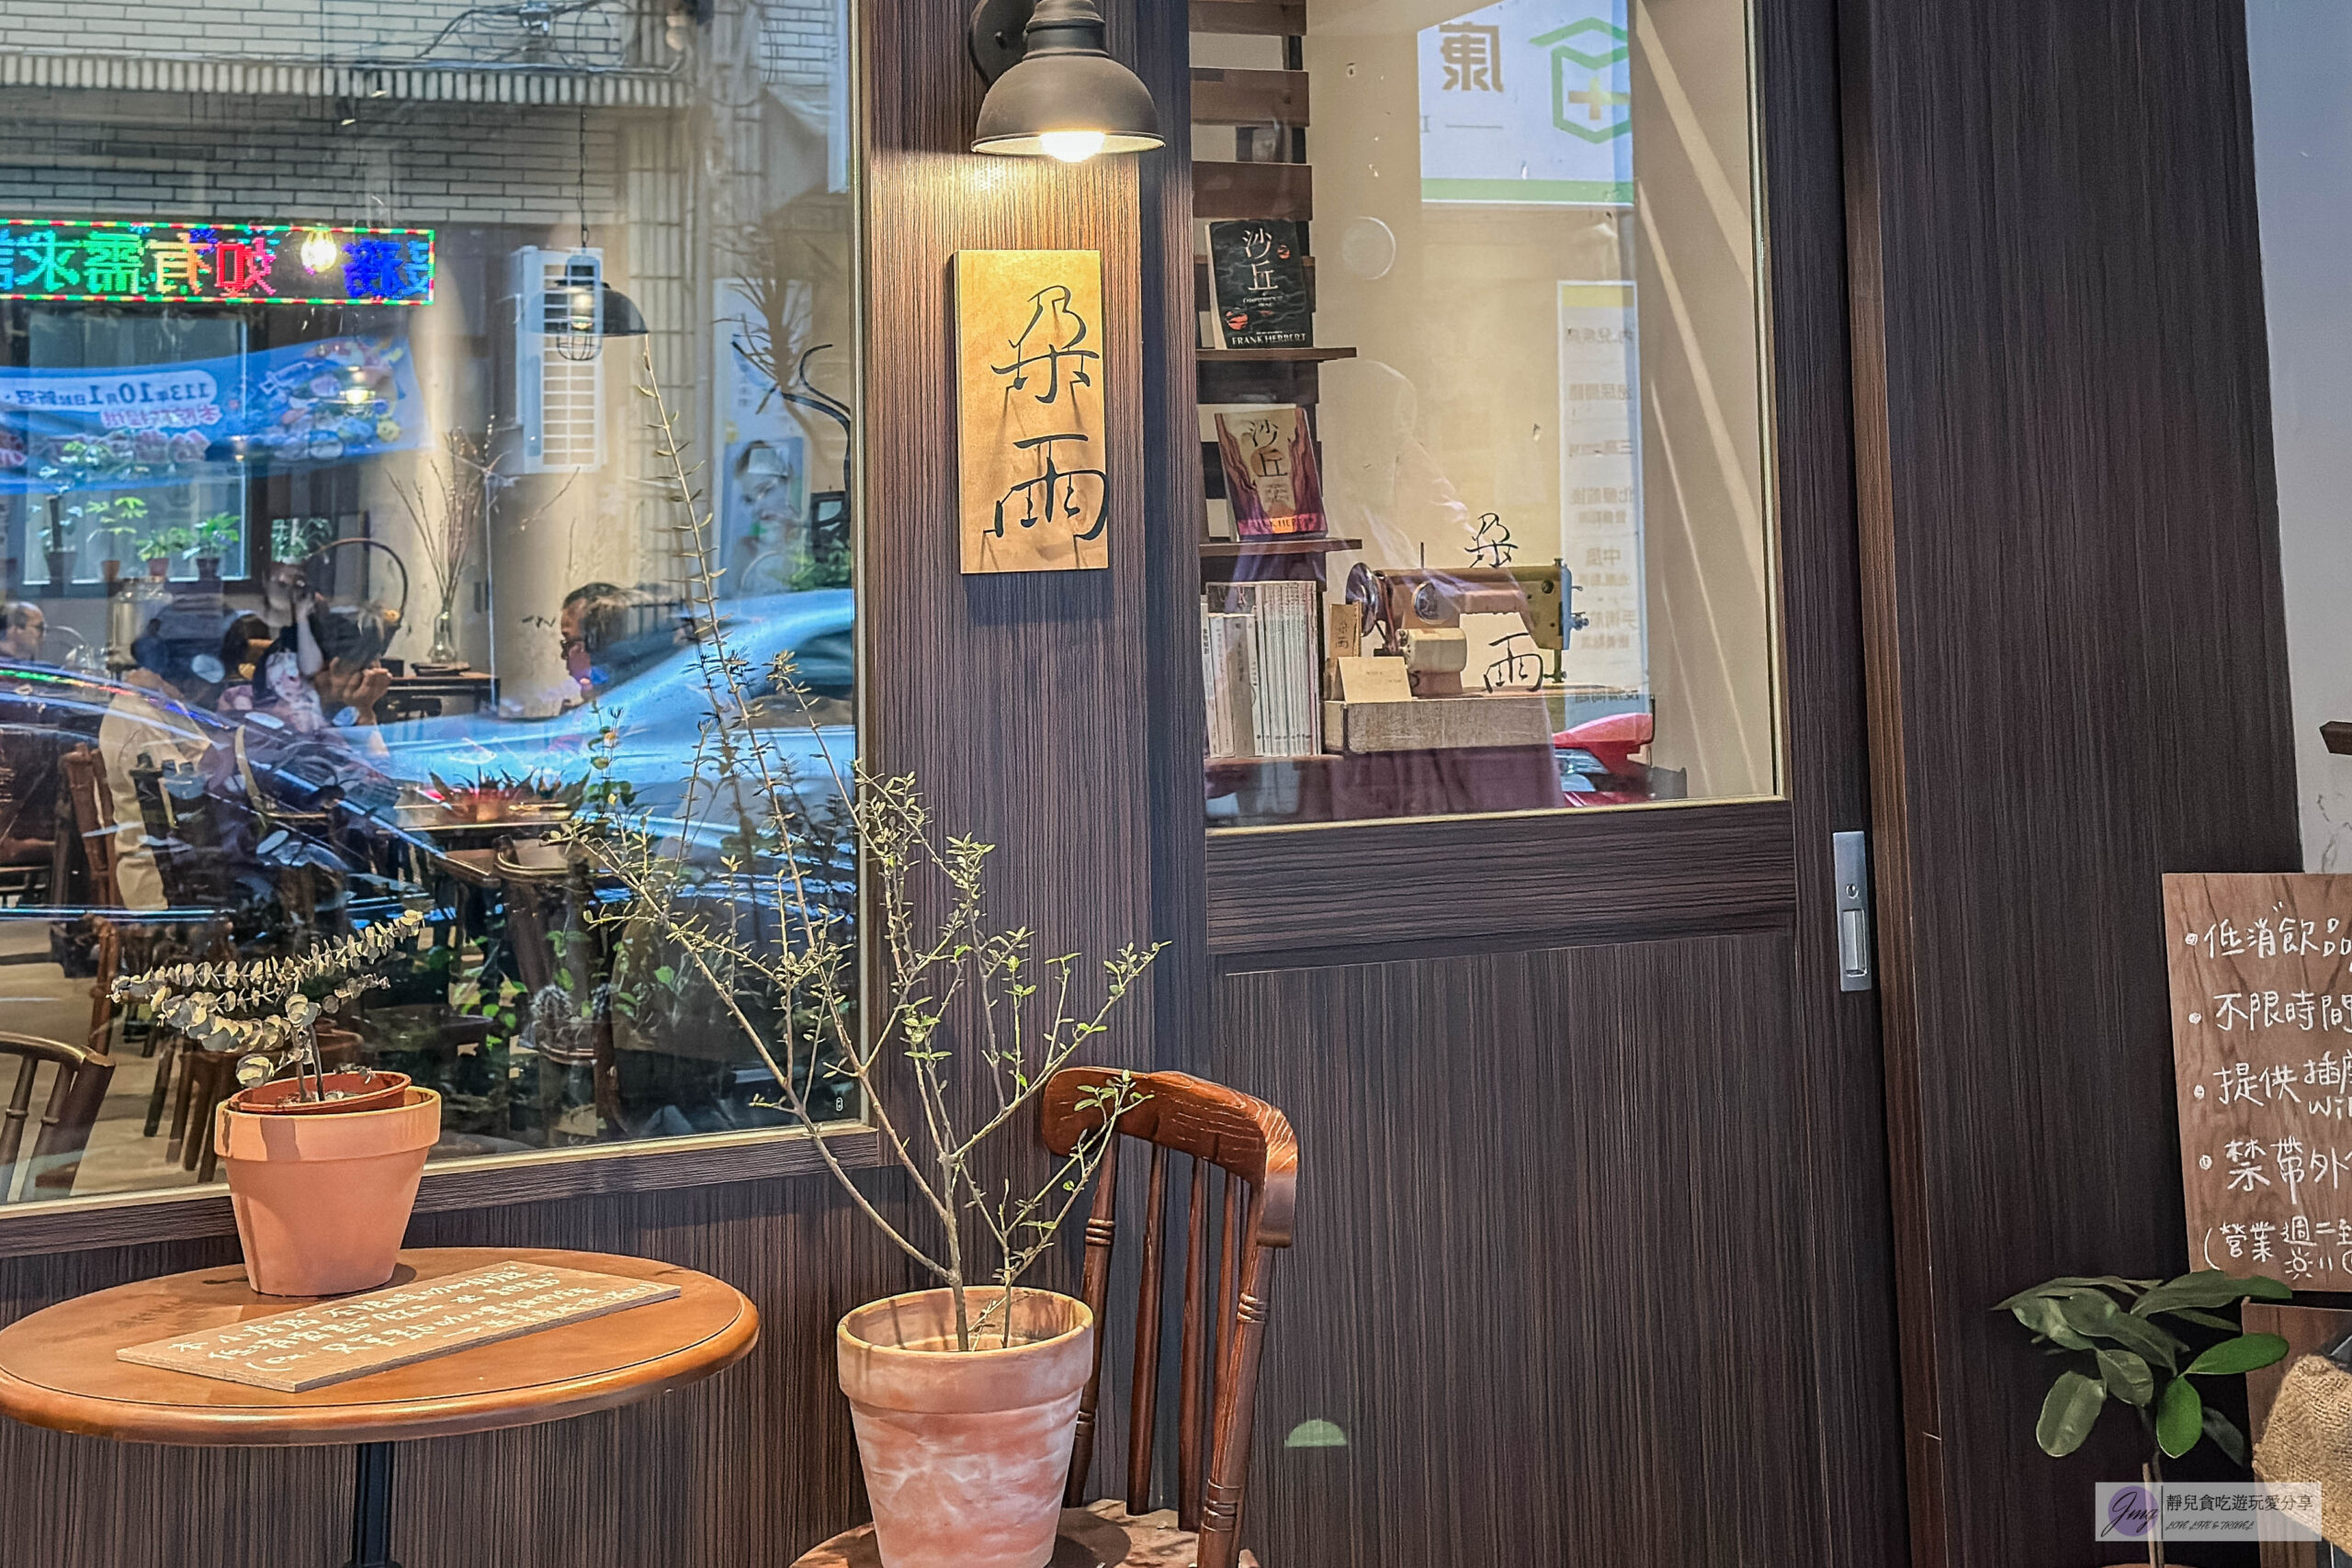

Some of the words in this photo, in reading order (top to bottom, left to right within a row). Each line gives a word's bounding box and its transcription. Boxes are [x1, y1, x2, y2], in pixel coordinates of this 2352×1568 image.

[1242, 227, 1279, 291] 沙丘
[1232, 335, 1262, 345] FRANK
[1264, 333, 1306, 344] HERBERT
[990, 286, 1109, 540] 朵雨
[1249, 419, 1289, 478] 沙丘
[2213, 989, 2352, 1033] 不限時間
